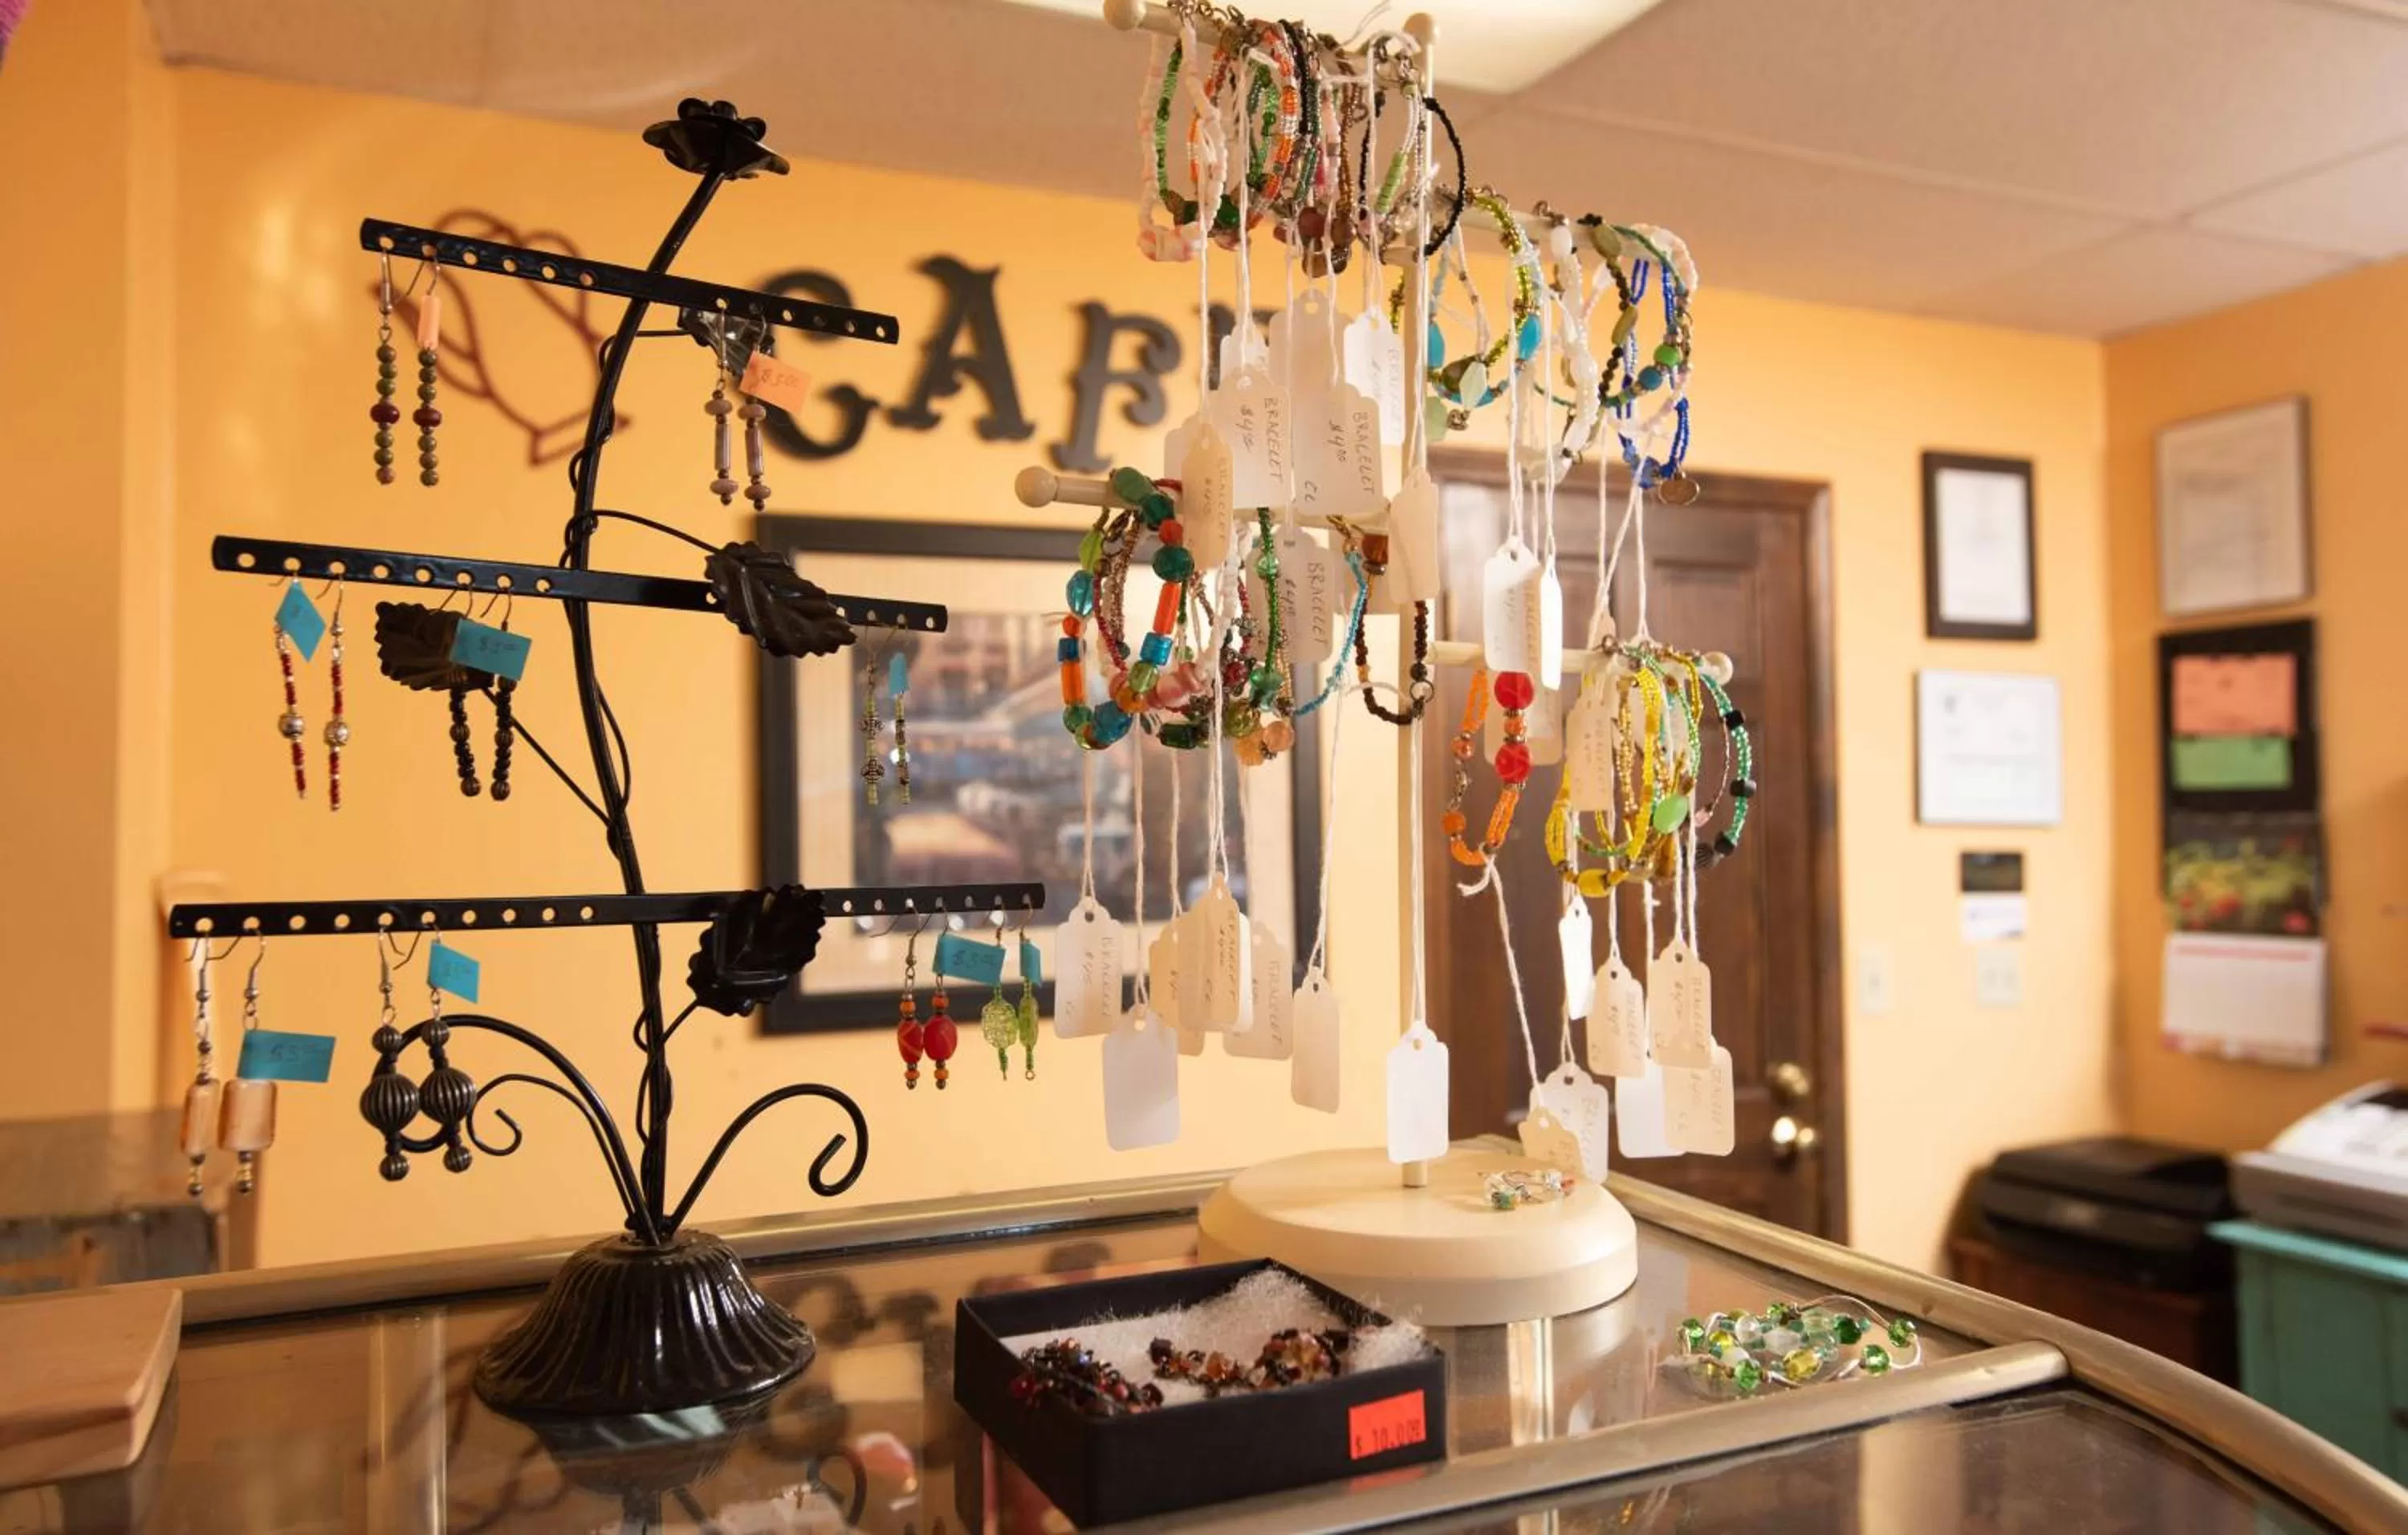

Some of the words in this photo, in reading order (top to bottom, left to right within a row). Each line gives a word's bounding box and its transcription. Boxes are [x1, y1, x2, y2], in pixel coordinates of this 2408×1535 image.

[1263, 397, 1284, 482] BRACELET
[1352, 411, 1374, 495] BRACELET
[1307, 562, 1330, 645] BRACELET
